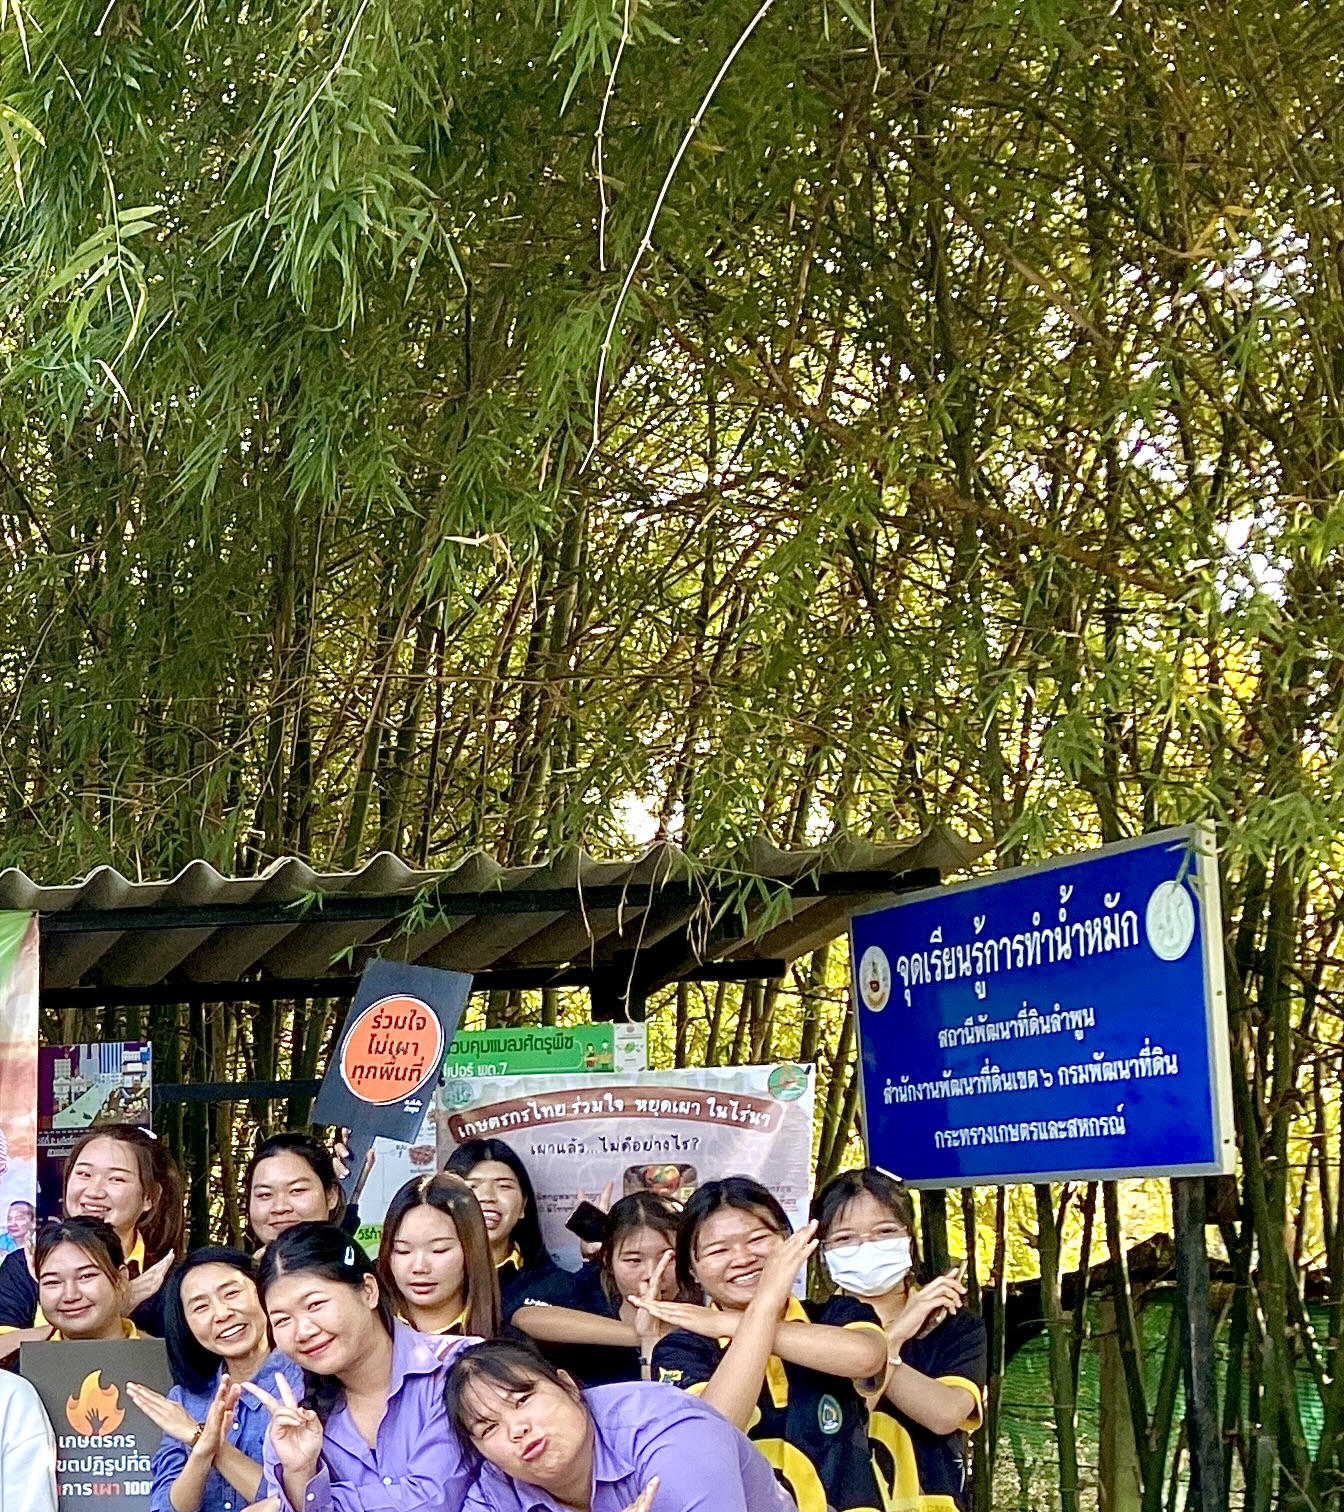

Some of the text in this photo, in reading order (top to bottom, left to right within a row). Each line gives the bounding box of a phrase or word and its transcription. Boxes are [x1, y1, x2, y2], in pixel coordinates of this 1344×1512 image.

[896, 885, 1139, 1007] จุดเรียนรู้การทำน้ำหมัก
[372, 1007, 427, 1031] ร่วมใจ
[938, 1001, 1095, 1049] สถานีพัฒนาที่ดินลำพูน
[367, 1033, 420, 1057] ไม่เผา
[448, 1033, 574, 1060] วบคุมแมลงศัตรูพืช
[351, 1055, 425, 1085] ทุกพื้นที่
[883, 1058, 1039, 1105] สำนักงานพัฒนาที่ดินเขต
[1057, 1038, 1179, 1086] กรมพัฒนาที่ดิน
[457, 1092, 771, 1138] เกษตรกรไทย ร่วมใจ หยุดเผา ในไร่นา
[934, 1103, 1127, 1149] กระทรวงเกษตรและสหกรณ์
[58, 1434, 136, 1449] เกษตรกร
[123, 1481, 153, 1496] 100
